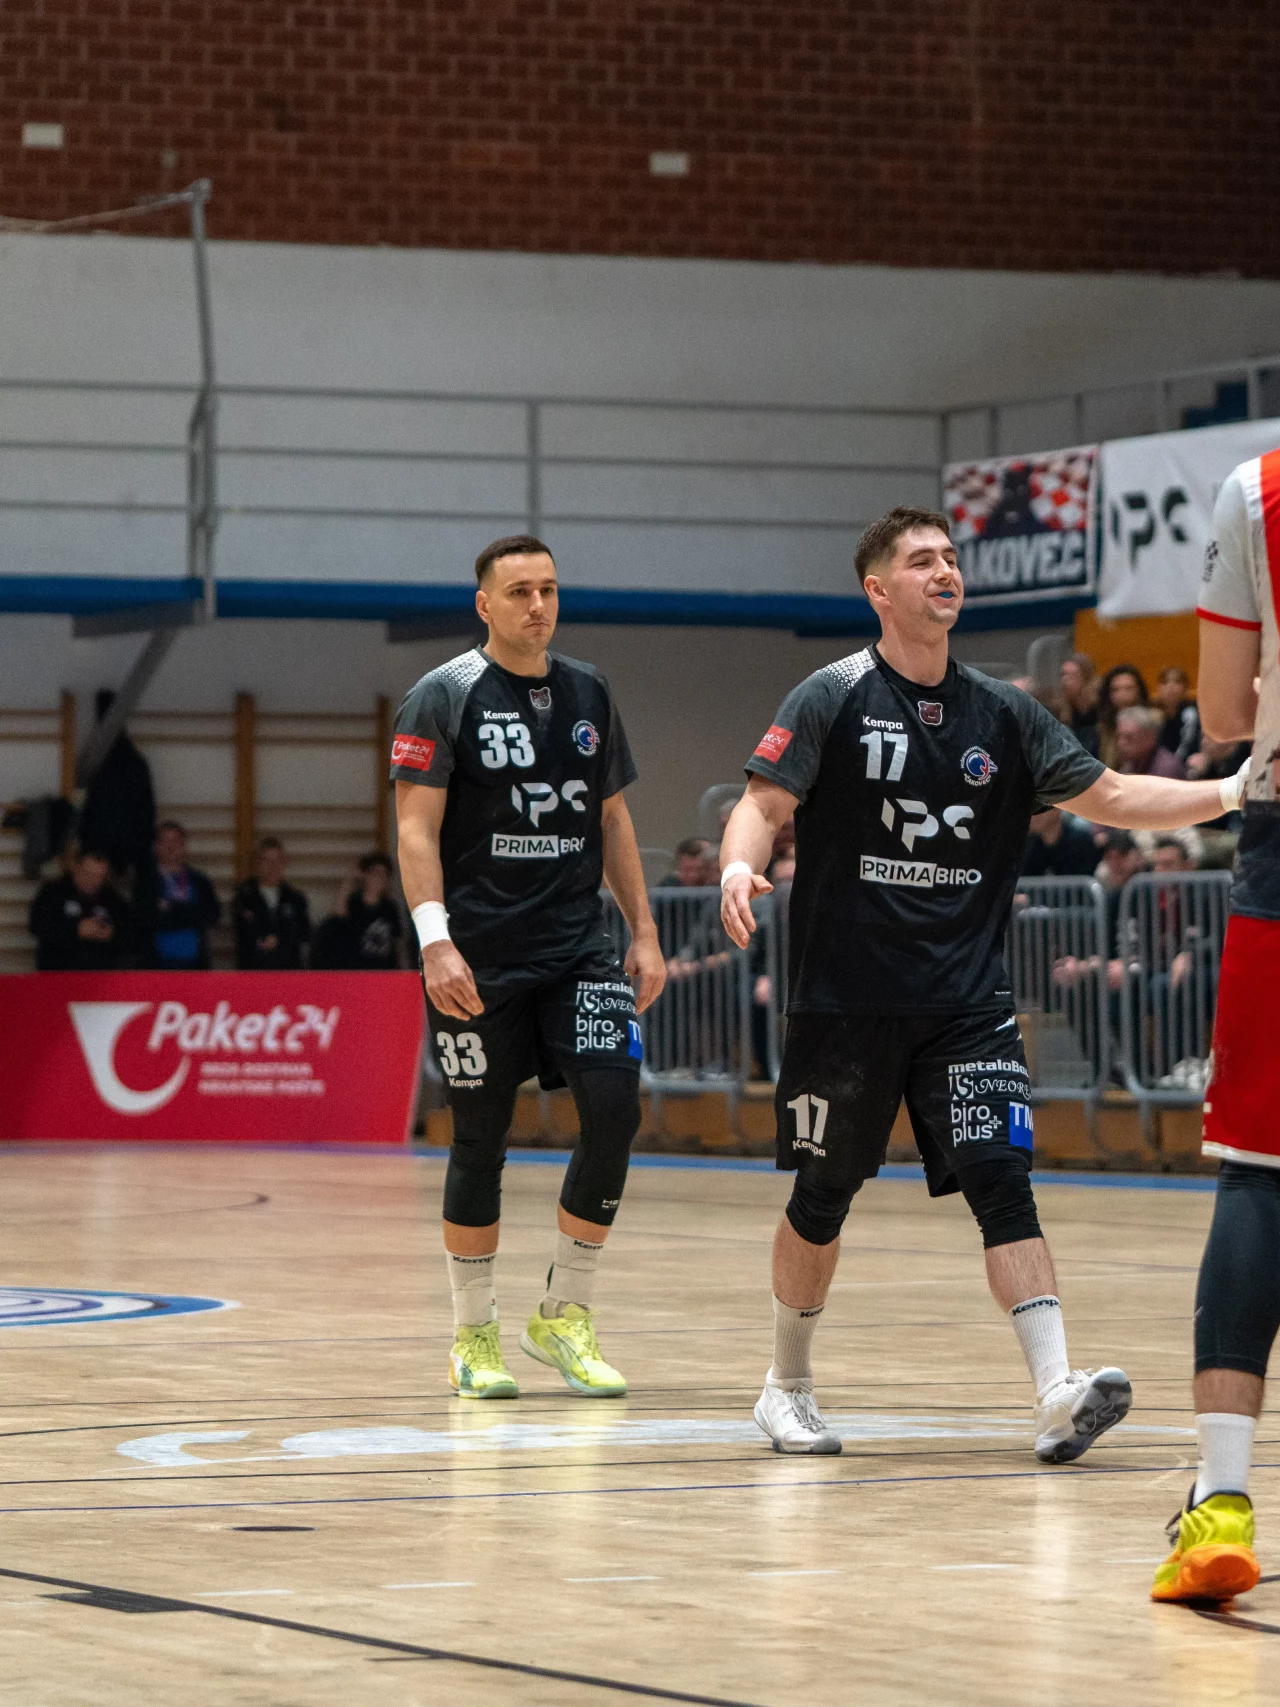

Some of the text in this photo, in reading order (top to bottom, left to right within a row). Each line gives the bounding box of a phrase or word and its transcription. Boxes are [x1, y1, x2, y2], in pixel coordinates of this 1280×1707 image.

[952, 528, 1084, 586] AKOVEC
[483, 711, 520, 721] Kempa
[862, 715, 904, 731] Kempa
[479, 723, 535, 769] 33
[860, 731, 909, 782] 17
[148, 1000, 341, 1052] Paket24
[576, 1014, 615, 1033] biro
[437, 1032, 487, 1077] 33
[449, 1078, 484, 1089] Kempa
[787, 1094, 829, 1145] 17
[951, 1102, 991, 1123] biro
[792, 1139, 826, 1157] Kempa
